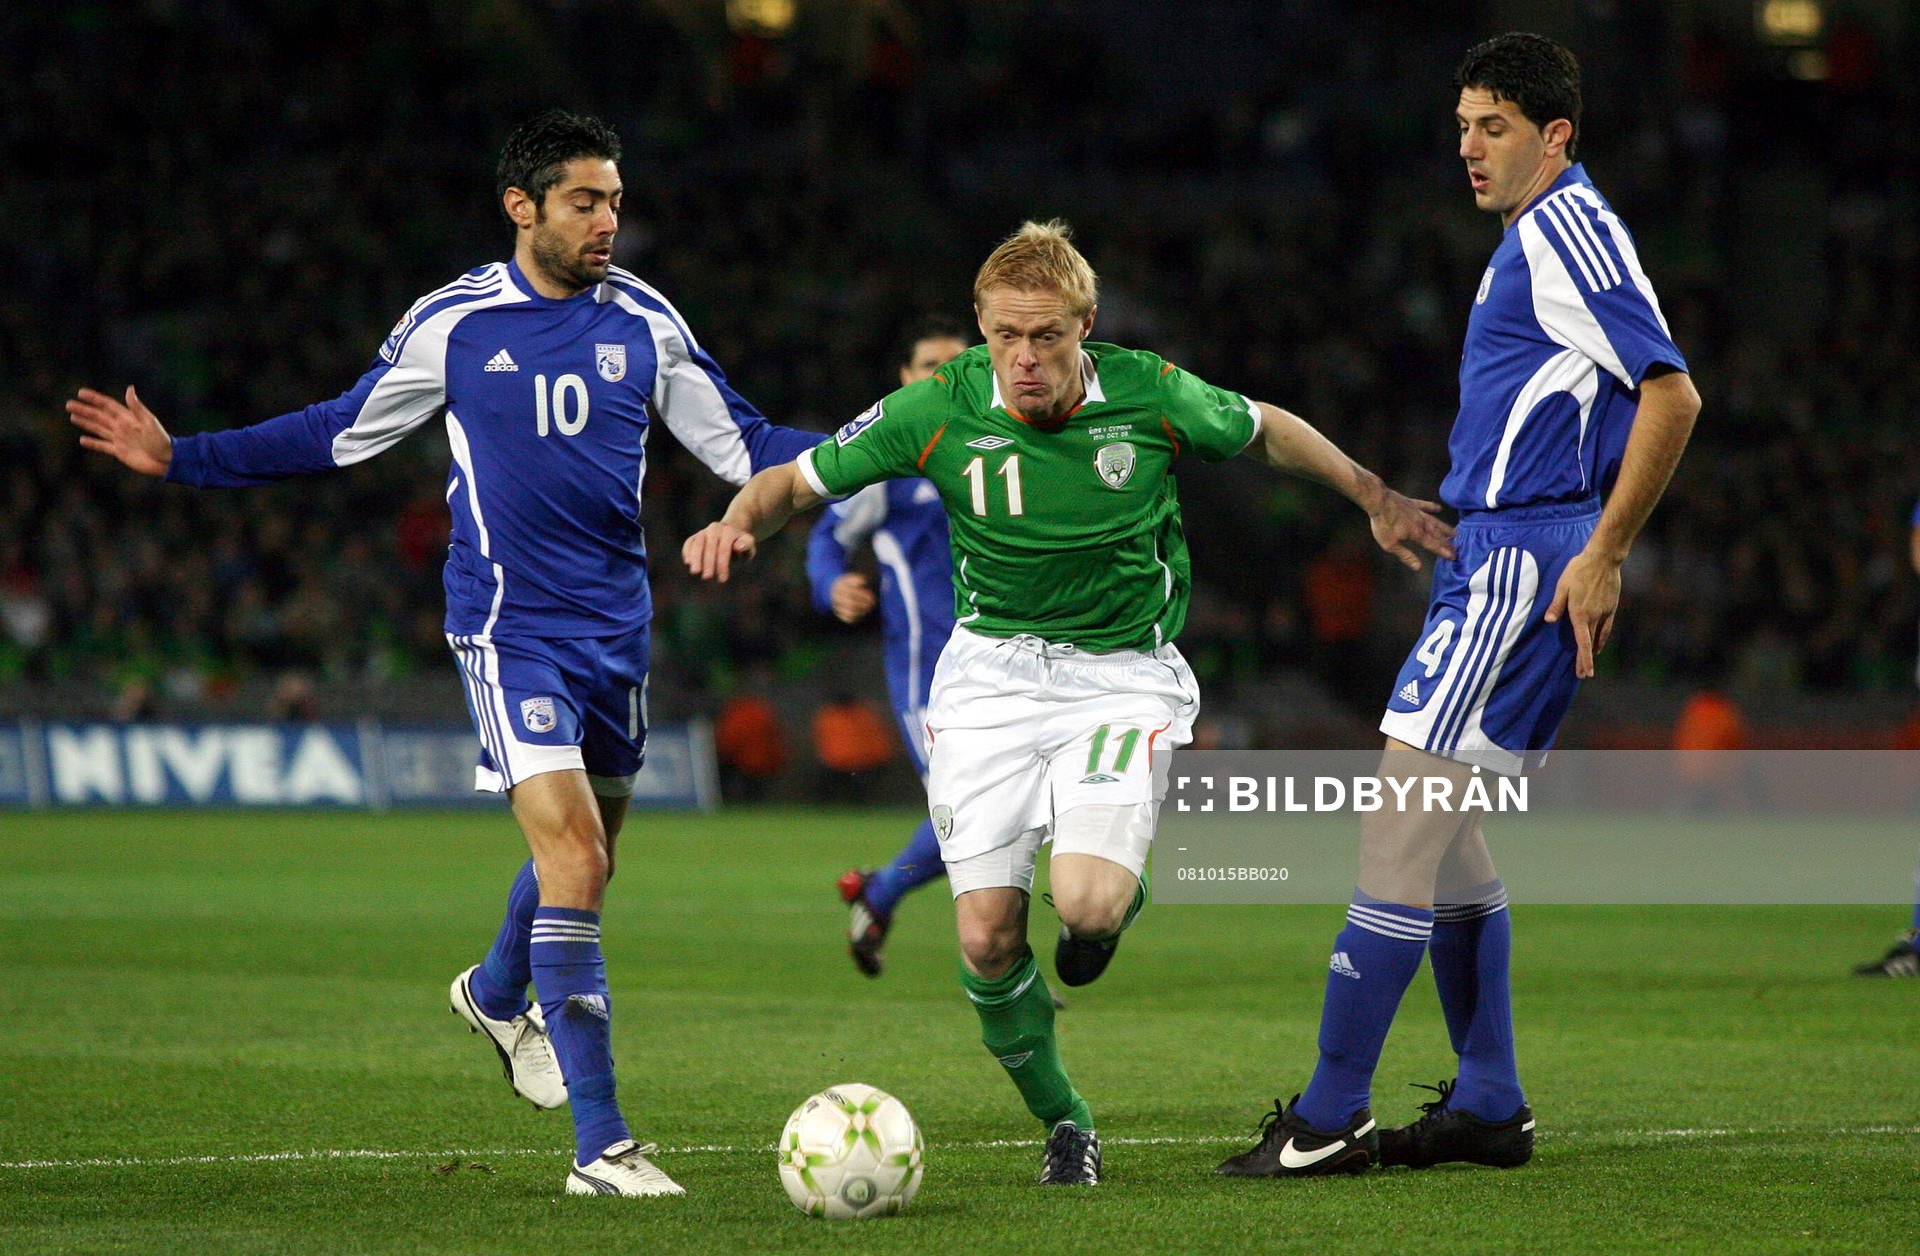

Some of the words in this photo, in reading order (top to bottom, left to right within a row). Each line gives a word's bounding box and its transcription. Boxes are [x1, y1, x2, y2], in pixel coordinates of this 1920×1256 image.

[484, 364, 519, 372] adidas
[534, 373, 590, 437] 10
[961, 454, 1024, 516] 11
[1416, 619, 1455, 678] 4
[51, 726, 362, 804] NIVEA
[1086, 724, 1143, 775] 11
